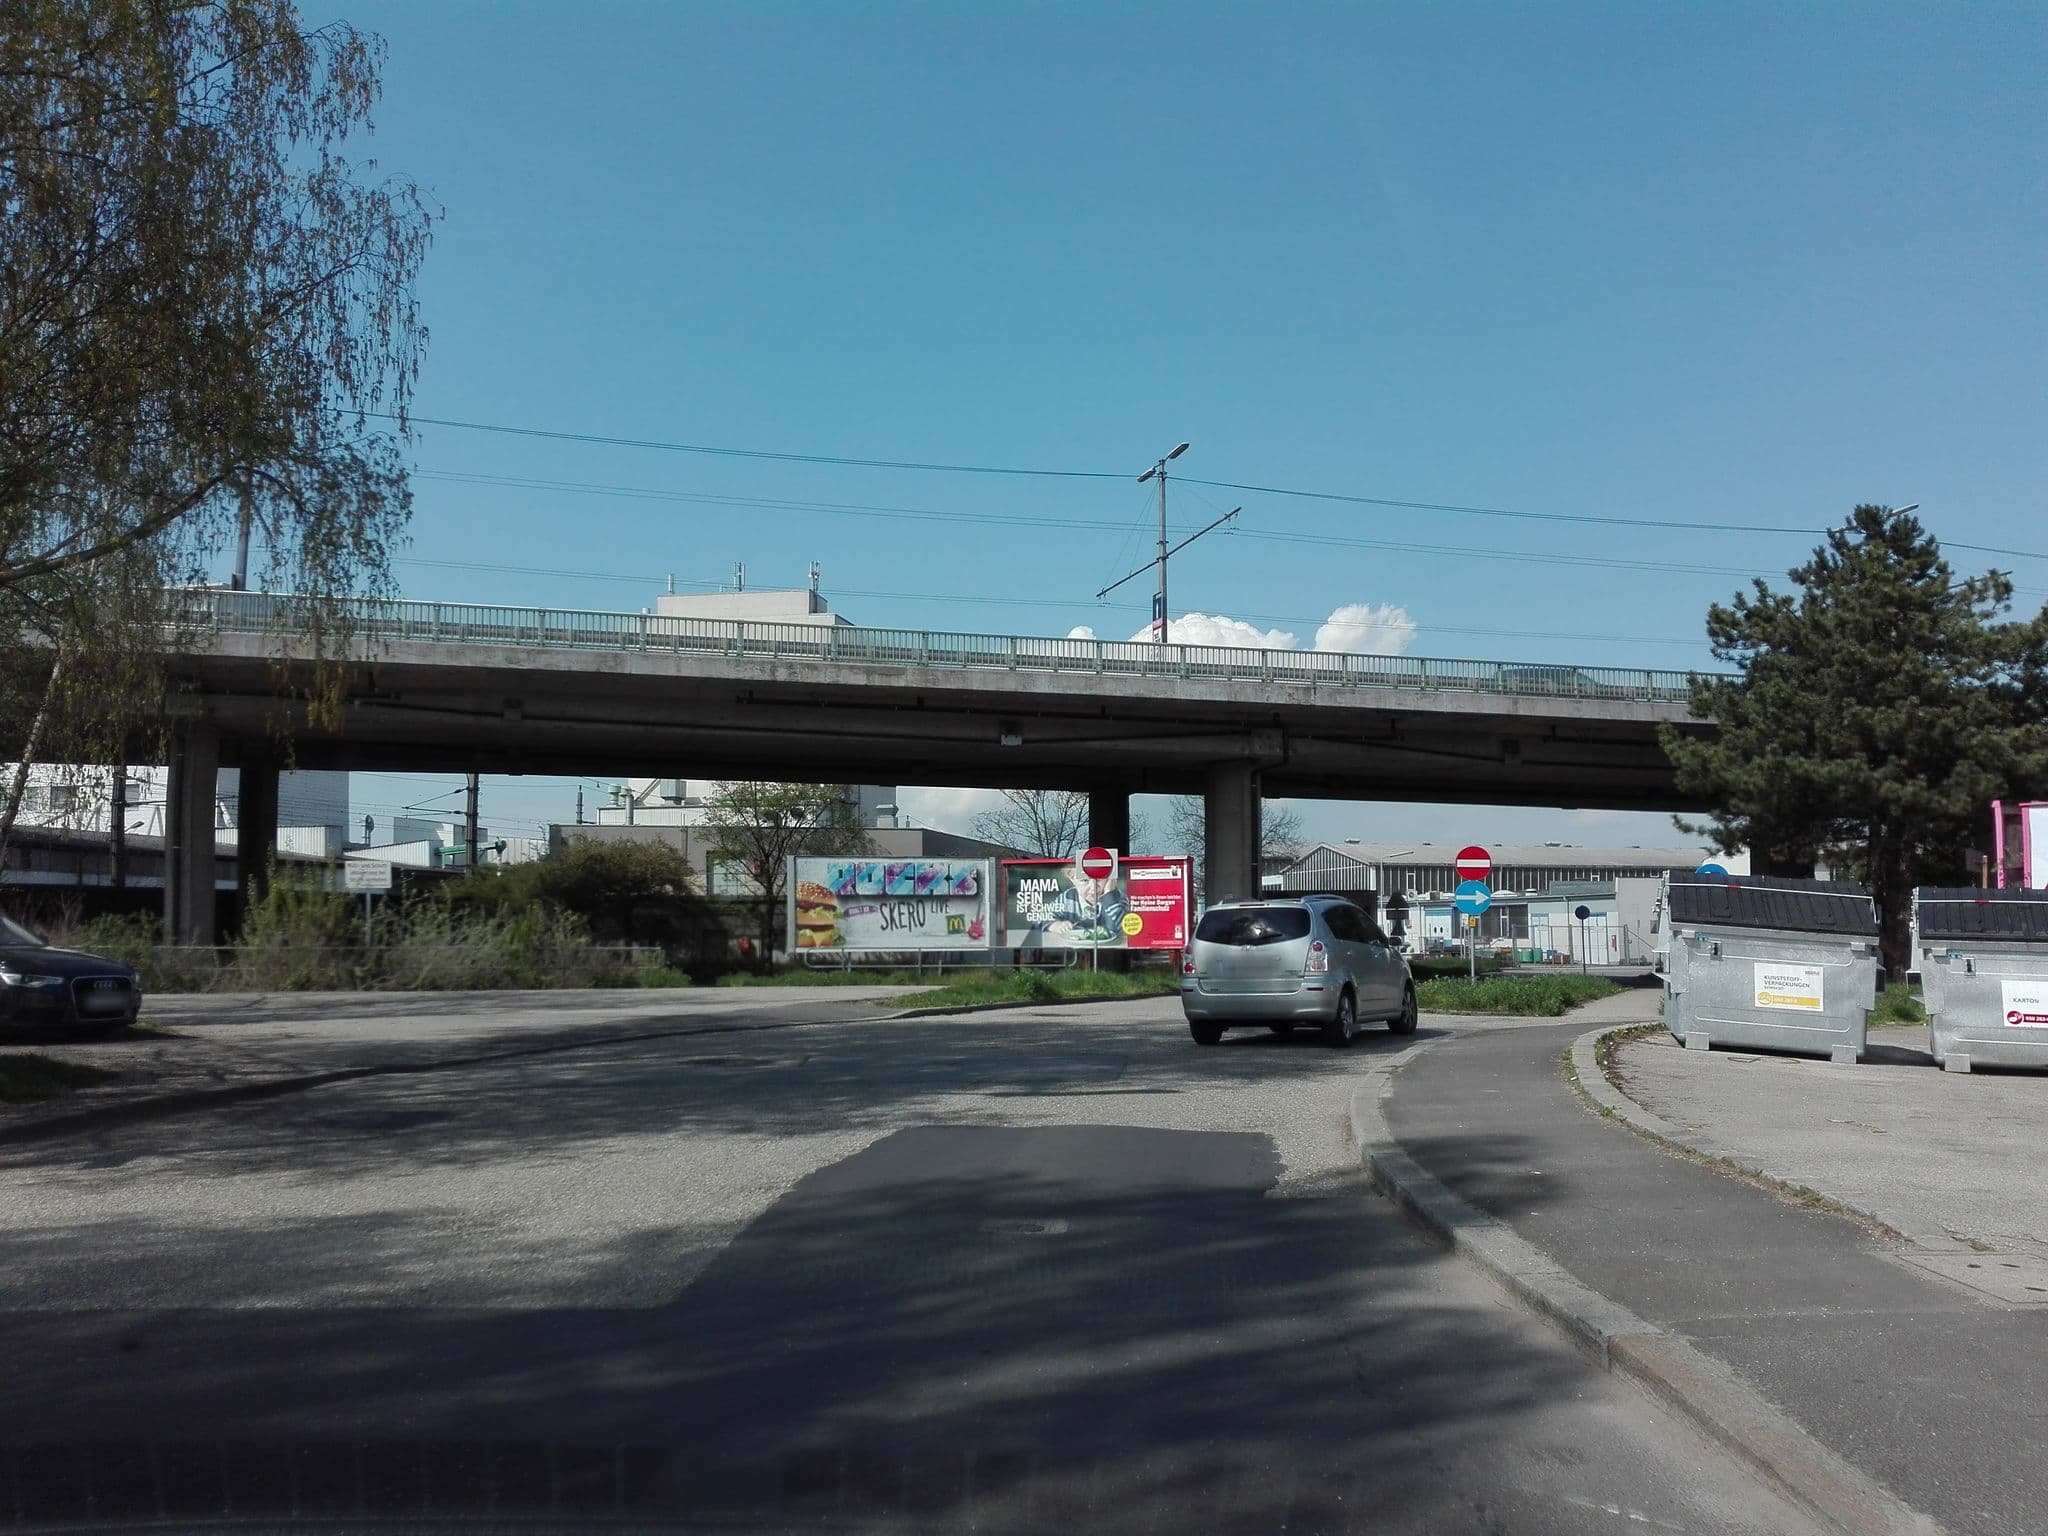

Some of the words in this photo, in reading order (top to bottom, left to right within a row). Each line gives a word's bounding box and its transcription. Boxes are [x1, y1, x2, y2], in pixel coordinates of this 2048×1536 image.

[1020, 879, 1059, 891] MAMA
[1016, 892, 1043, 904] SEIN
[931, 899, 950, 914] LIVE
[1016, 904, 1028, 913] IST
[1031, 903, 1065, 913] SCHWER
[880, 900, 925, 932] SKERO
[1764, 980, 1810, 988] VERPACKUNGEN
